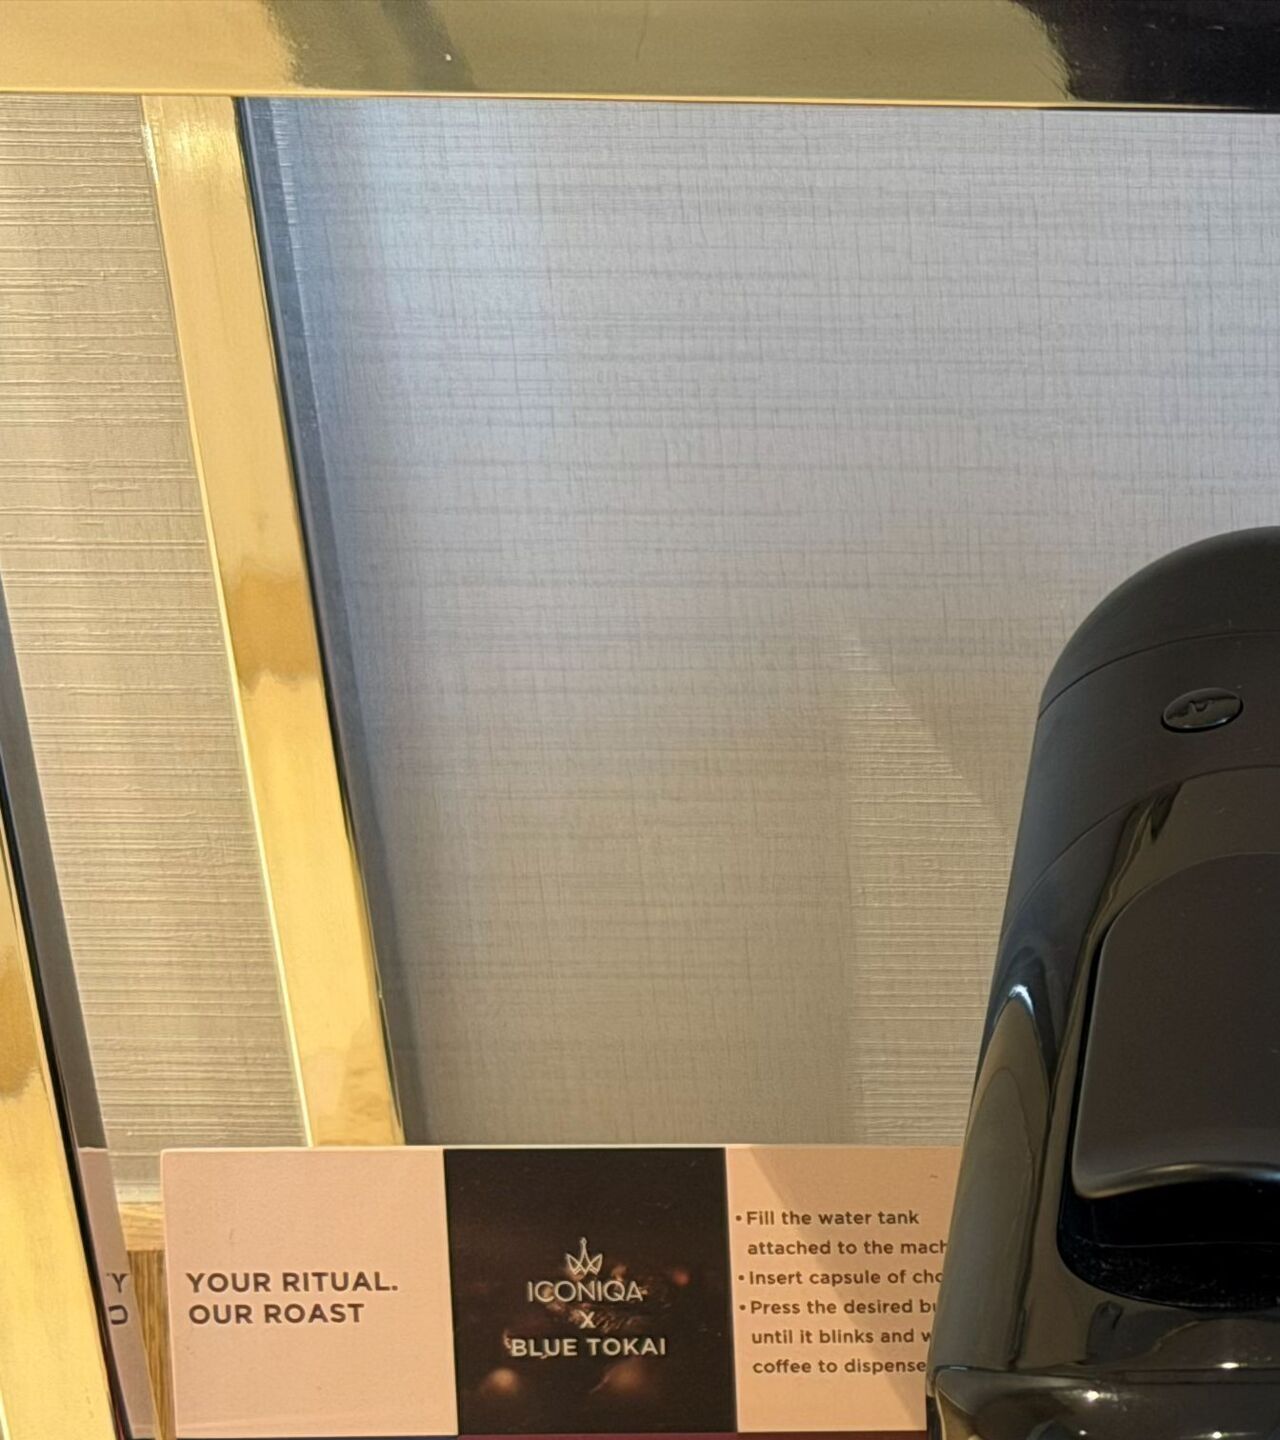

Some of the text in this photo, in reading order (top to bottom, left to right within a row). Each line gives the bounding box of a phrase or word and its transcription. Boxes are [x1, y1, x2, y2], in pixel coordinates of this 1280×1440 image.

[747, 1210, 919, 1225] Fill the water tank
[748, 1240, 948, 1255] attached to the mach
[186, 1272, 398, 1292] YOUR RITUAL.
[749, 1271, 803, 1284] Insert
[809, 1270, 881, 1287] capsule
[887, 1270, 906, 1284] of
[528, 1280, 643, 1302] ICONIQA
[189, 1304, 364, 1324] OUR ROAST
[751, 1301, 800, 1314] Press
[807, 1301, 836, 1314] the
[844, 1300, 913, 1314] desired
[752, 1331, 793, 1344] until
[800, 1330, 812, 1343] it
[819, 1330, 874, 1343] blinks
[881, 1329, 914, 1342] and
[511, 1338, 666, 1357] BLUE TOKAI
[753, 1359, 927, 1375] coffee to dispense
